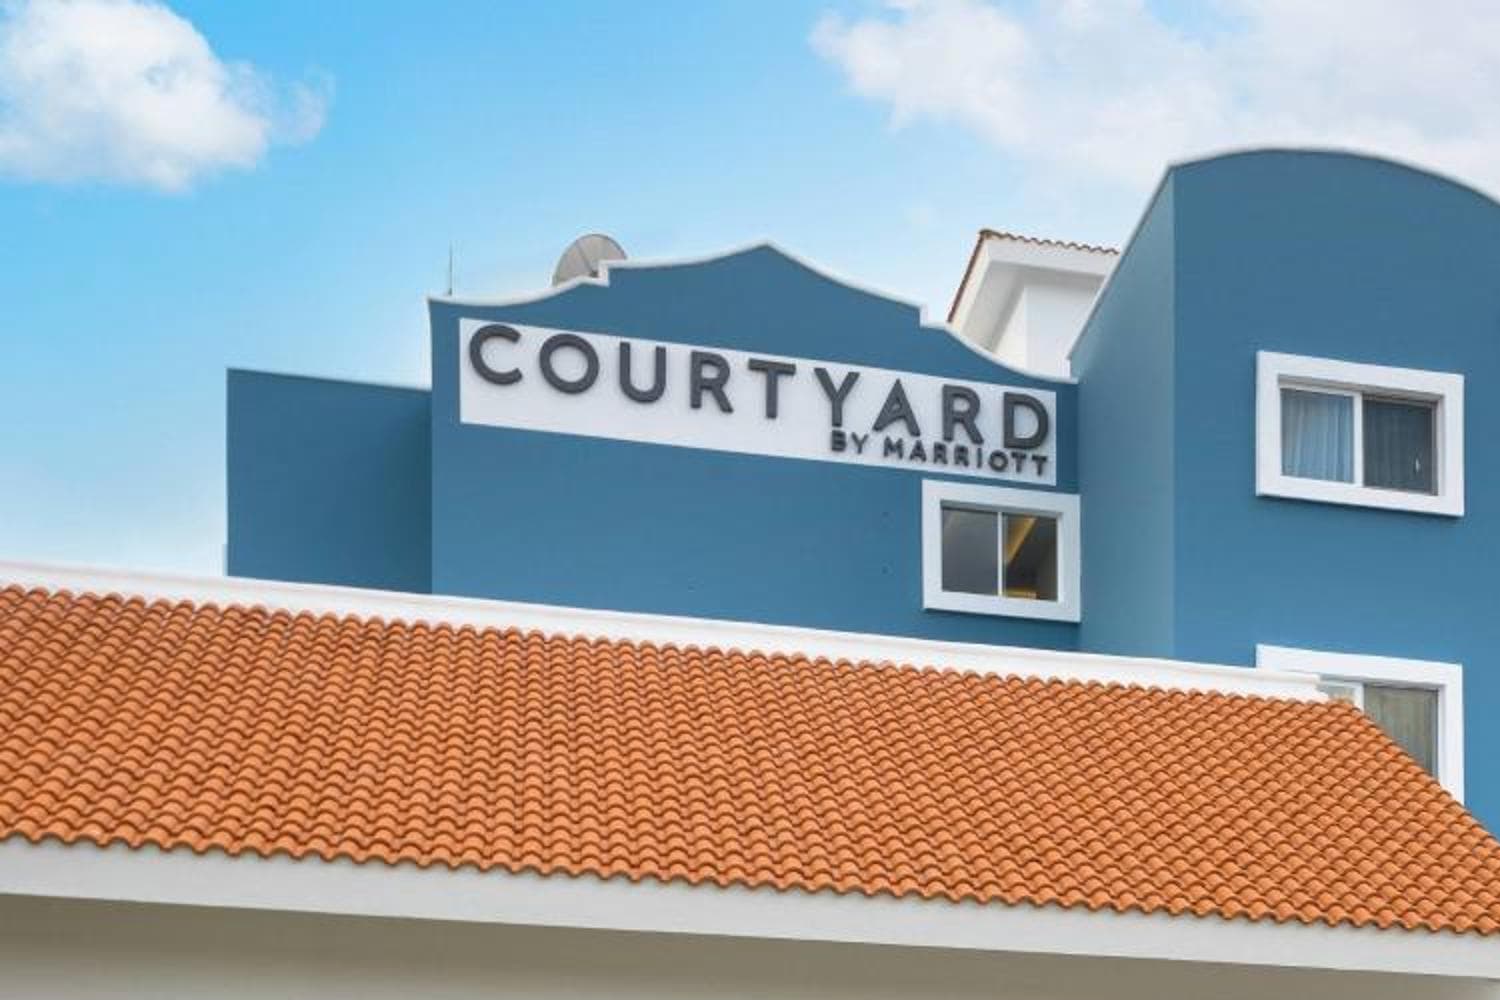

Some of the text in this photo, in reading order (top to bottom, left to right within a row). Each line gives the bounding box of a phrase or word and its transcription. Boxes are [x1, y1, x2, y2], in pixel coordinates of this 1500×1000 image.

[469, 323, 1050, 450] COURTYARD
[831, 429, 1048, 477] BY MARRIOTT
